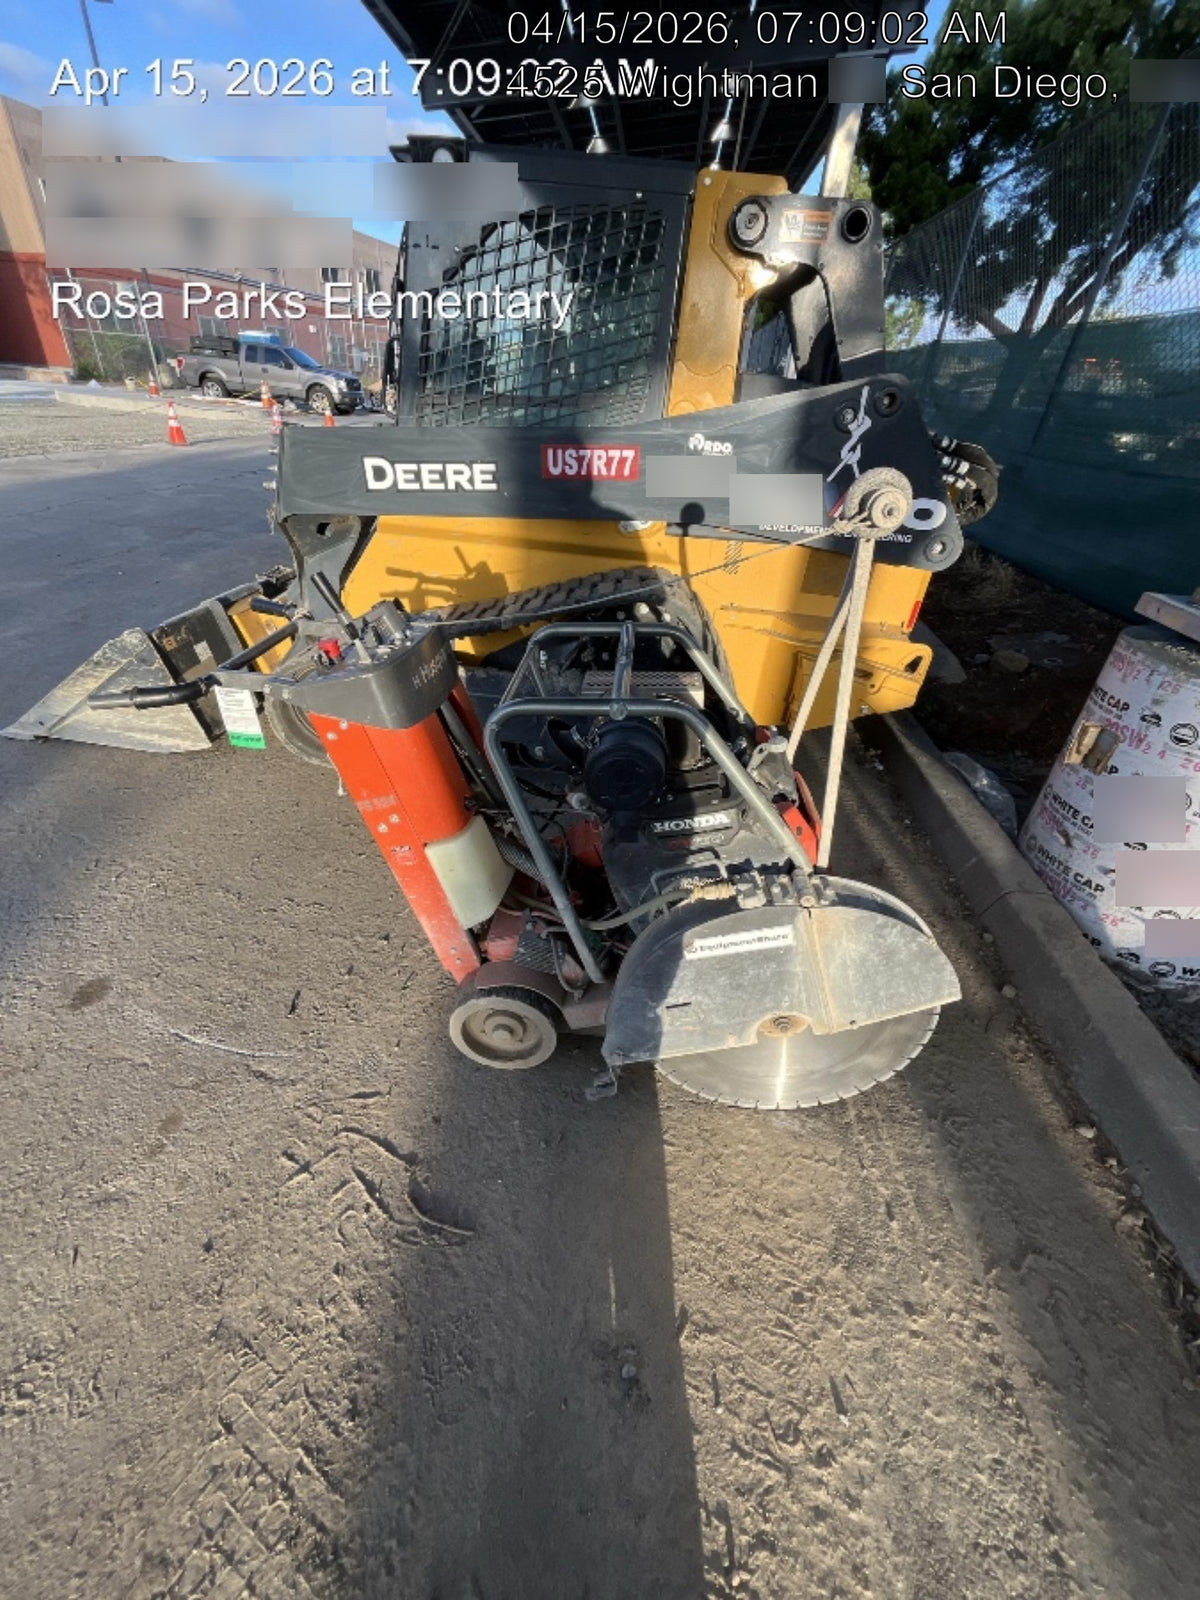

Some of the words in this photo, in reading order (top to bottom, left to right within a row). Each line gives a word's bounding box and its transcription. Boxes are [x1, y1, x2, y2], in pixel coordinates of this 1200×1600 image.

[362, 456, 499, 491] DEERE
[546, 447, 636, 477] US7R77
[1050, 792, 1079, 821] WHITE
[653, 813, 730, 833] HONDA
[1037, 844, 1072, 877] WHITE
[1073, 871, 1106, 894] CAP
